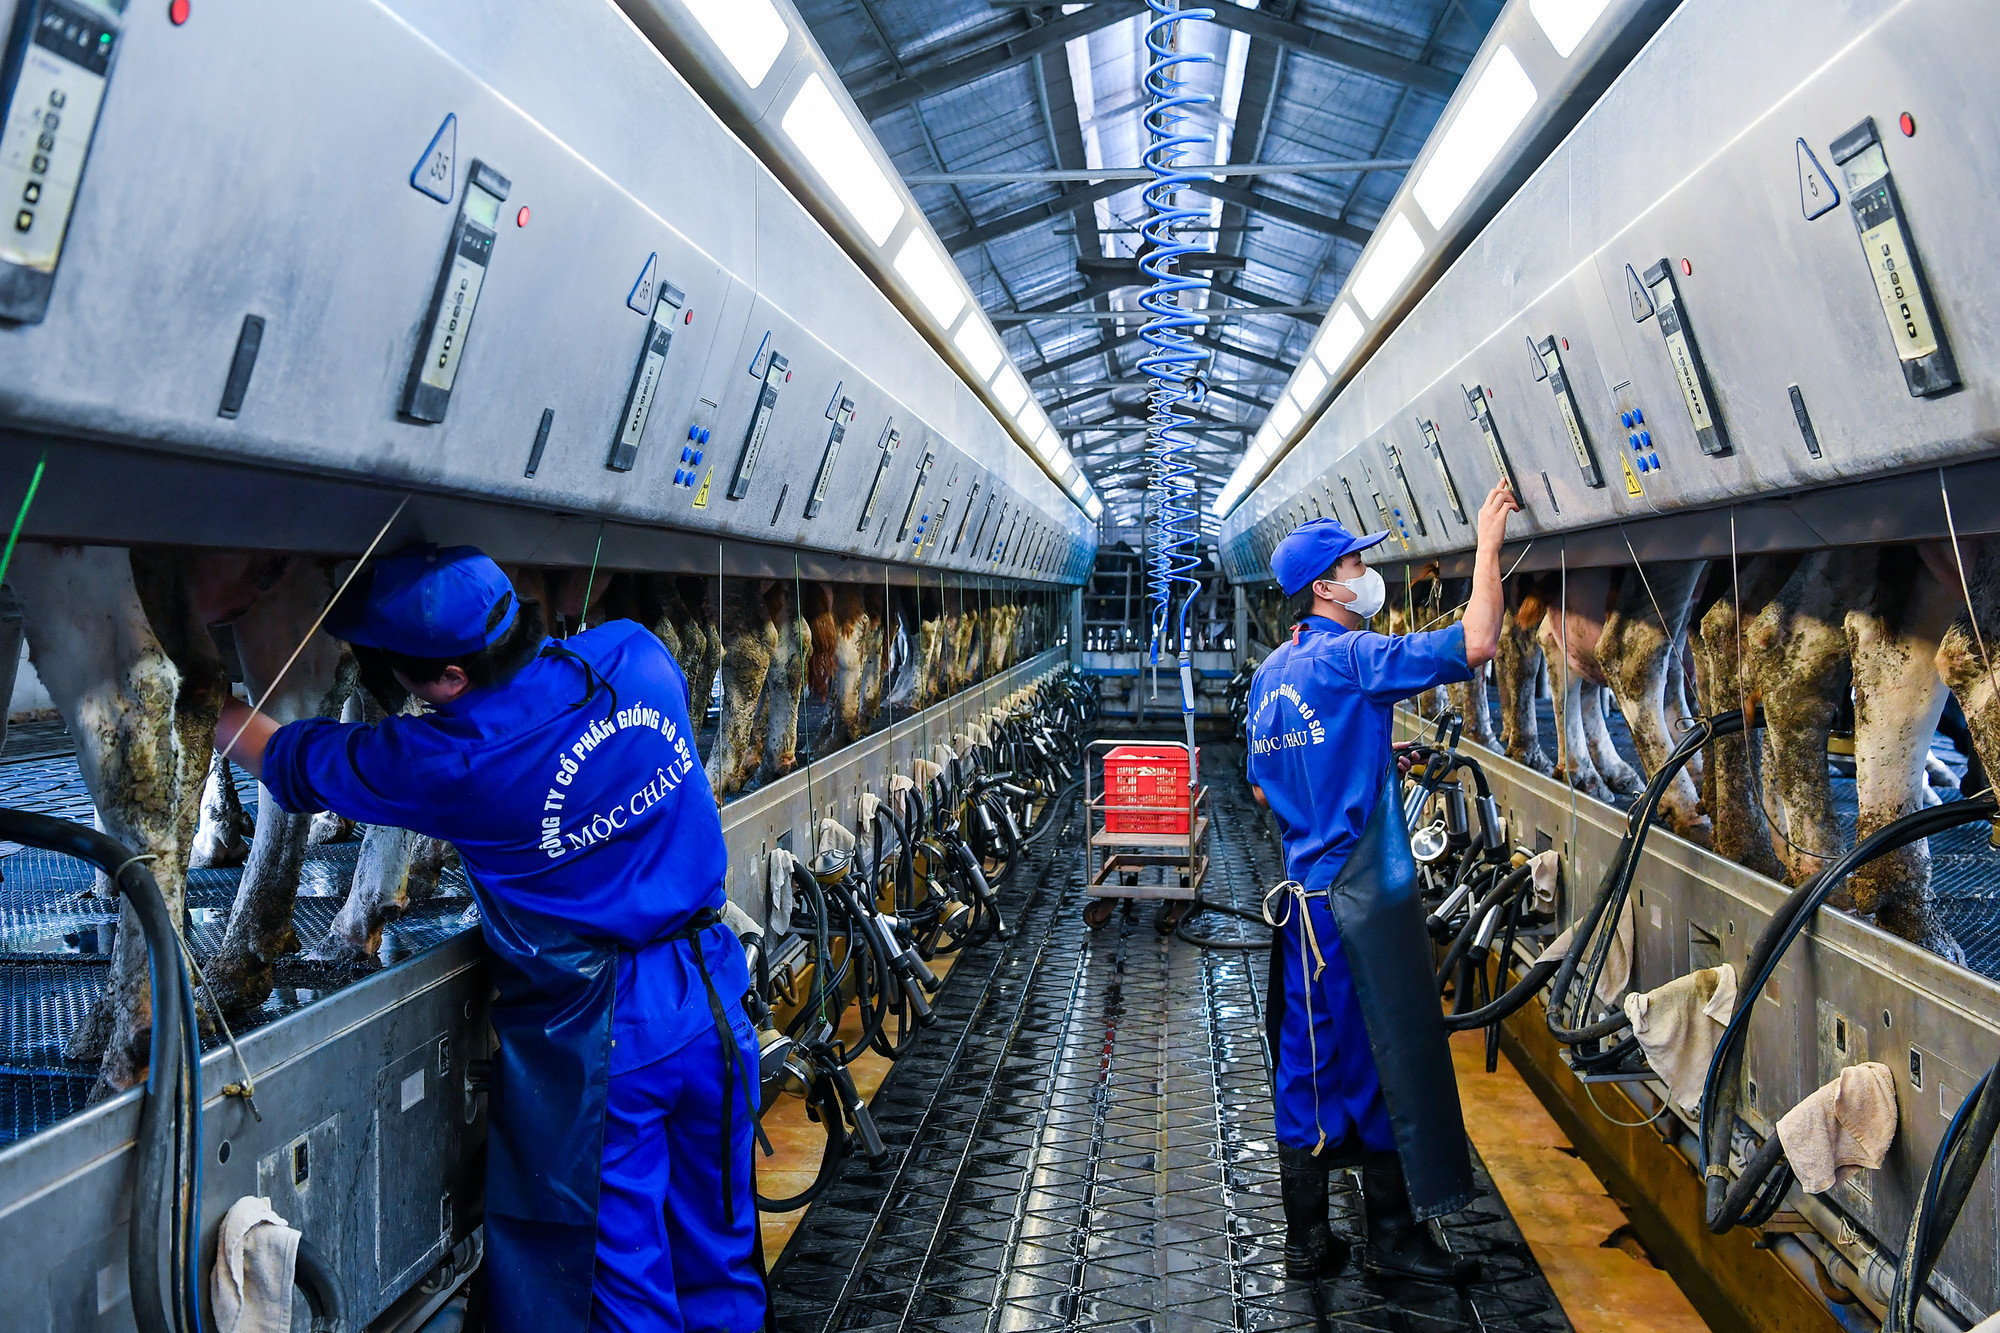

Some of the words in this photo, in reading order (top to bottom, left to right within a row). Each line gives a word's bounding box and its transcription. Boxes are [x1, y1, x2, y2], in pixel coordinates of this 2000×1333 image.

[1807, 174, 1819, 198] 5
[616, 700, 661, 730] GIỐNG
[661, 715, 677, 743] BÒ
[572, 718, 617, 762] PHẦN
[1253, 734, 1281, 756] MỘC
[1282, 727, 1307, 748] CHÂU
[1308, 719, 1325, 744] SỮA
[555, 752, 579, 787] CỔ
[544, 787, 566, 811] TY
[565, 805, 628, 851] MỘC
[629, 758, 684, 816] CHÂU
[539, 816, 567, 859] CÔNG
